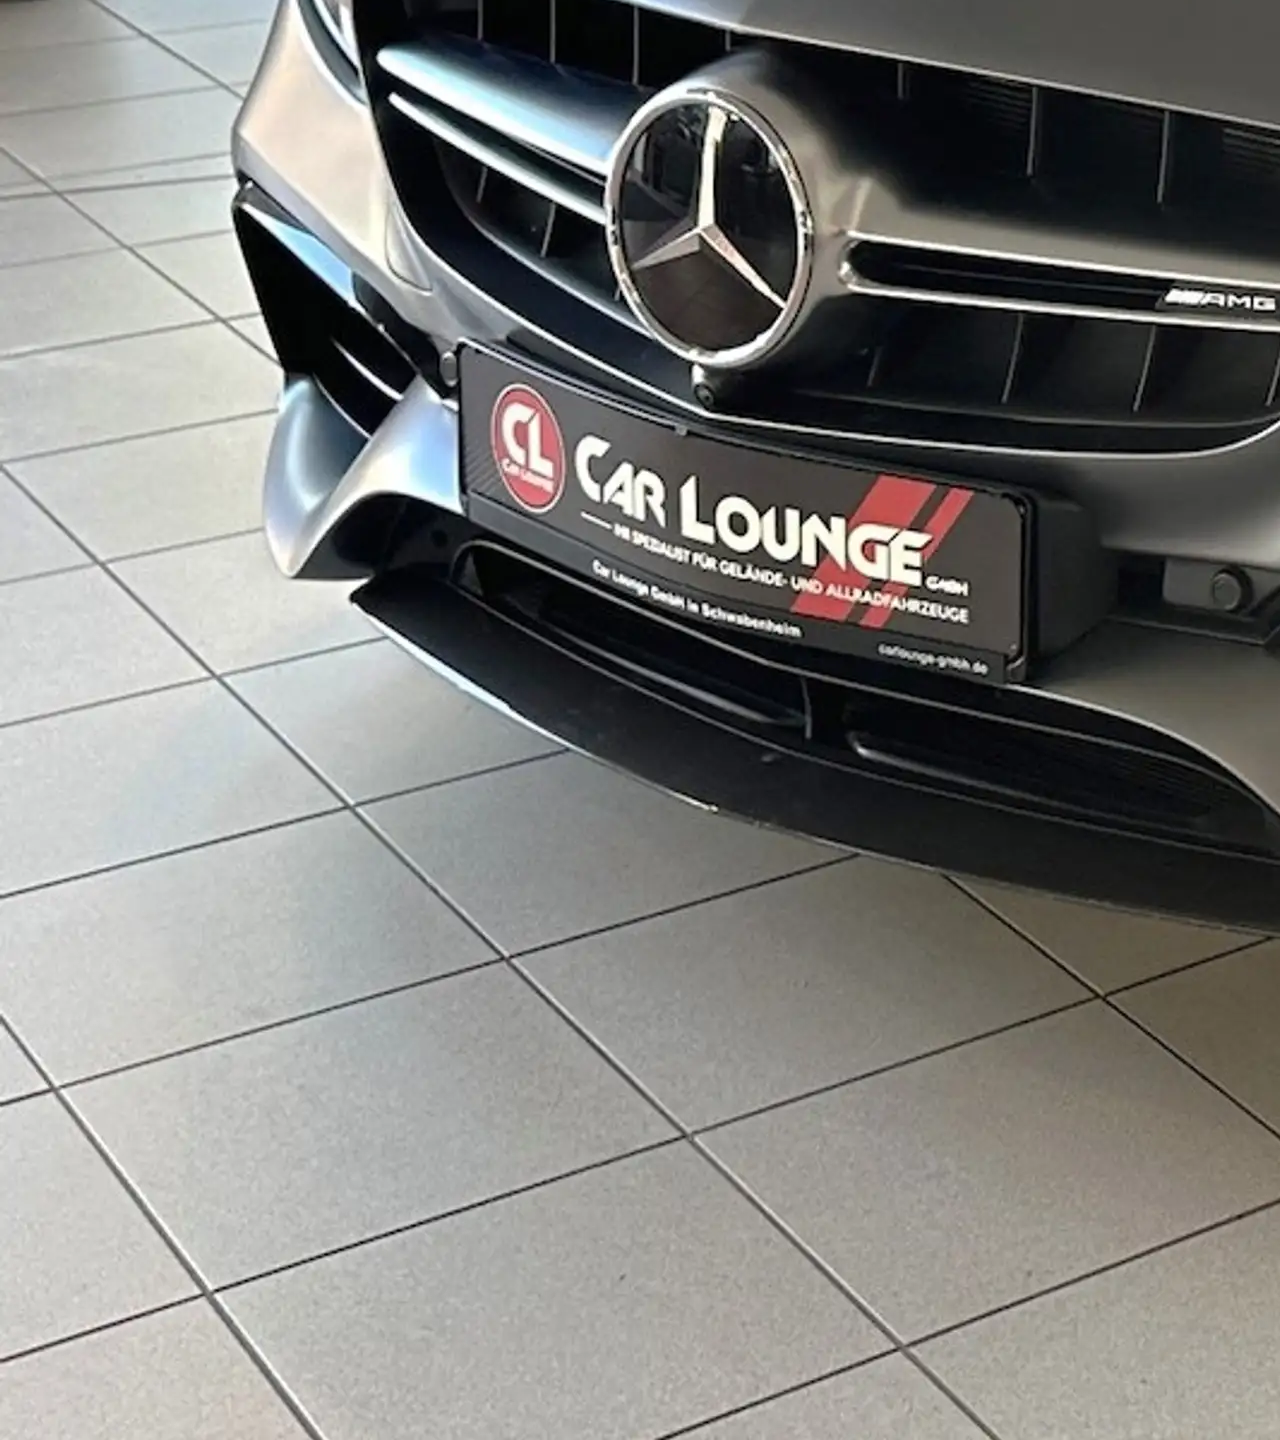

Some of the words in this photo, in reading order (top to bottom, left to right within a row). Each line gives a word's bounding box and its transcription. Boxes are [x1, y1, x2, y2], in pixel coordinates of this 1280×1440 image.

[502, 402, 554, 478] CL
[574, 434, 666, 528] CAR
[680, 474, 934, 587] LOUNGE
[790, 575, 823, 594] UND
[826, 582, 969, 624] ALLRADFAHRZEUGE
